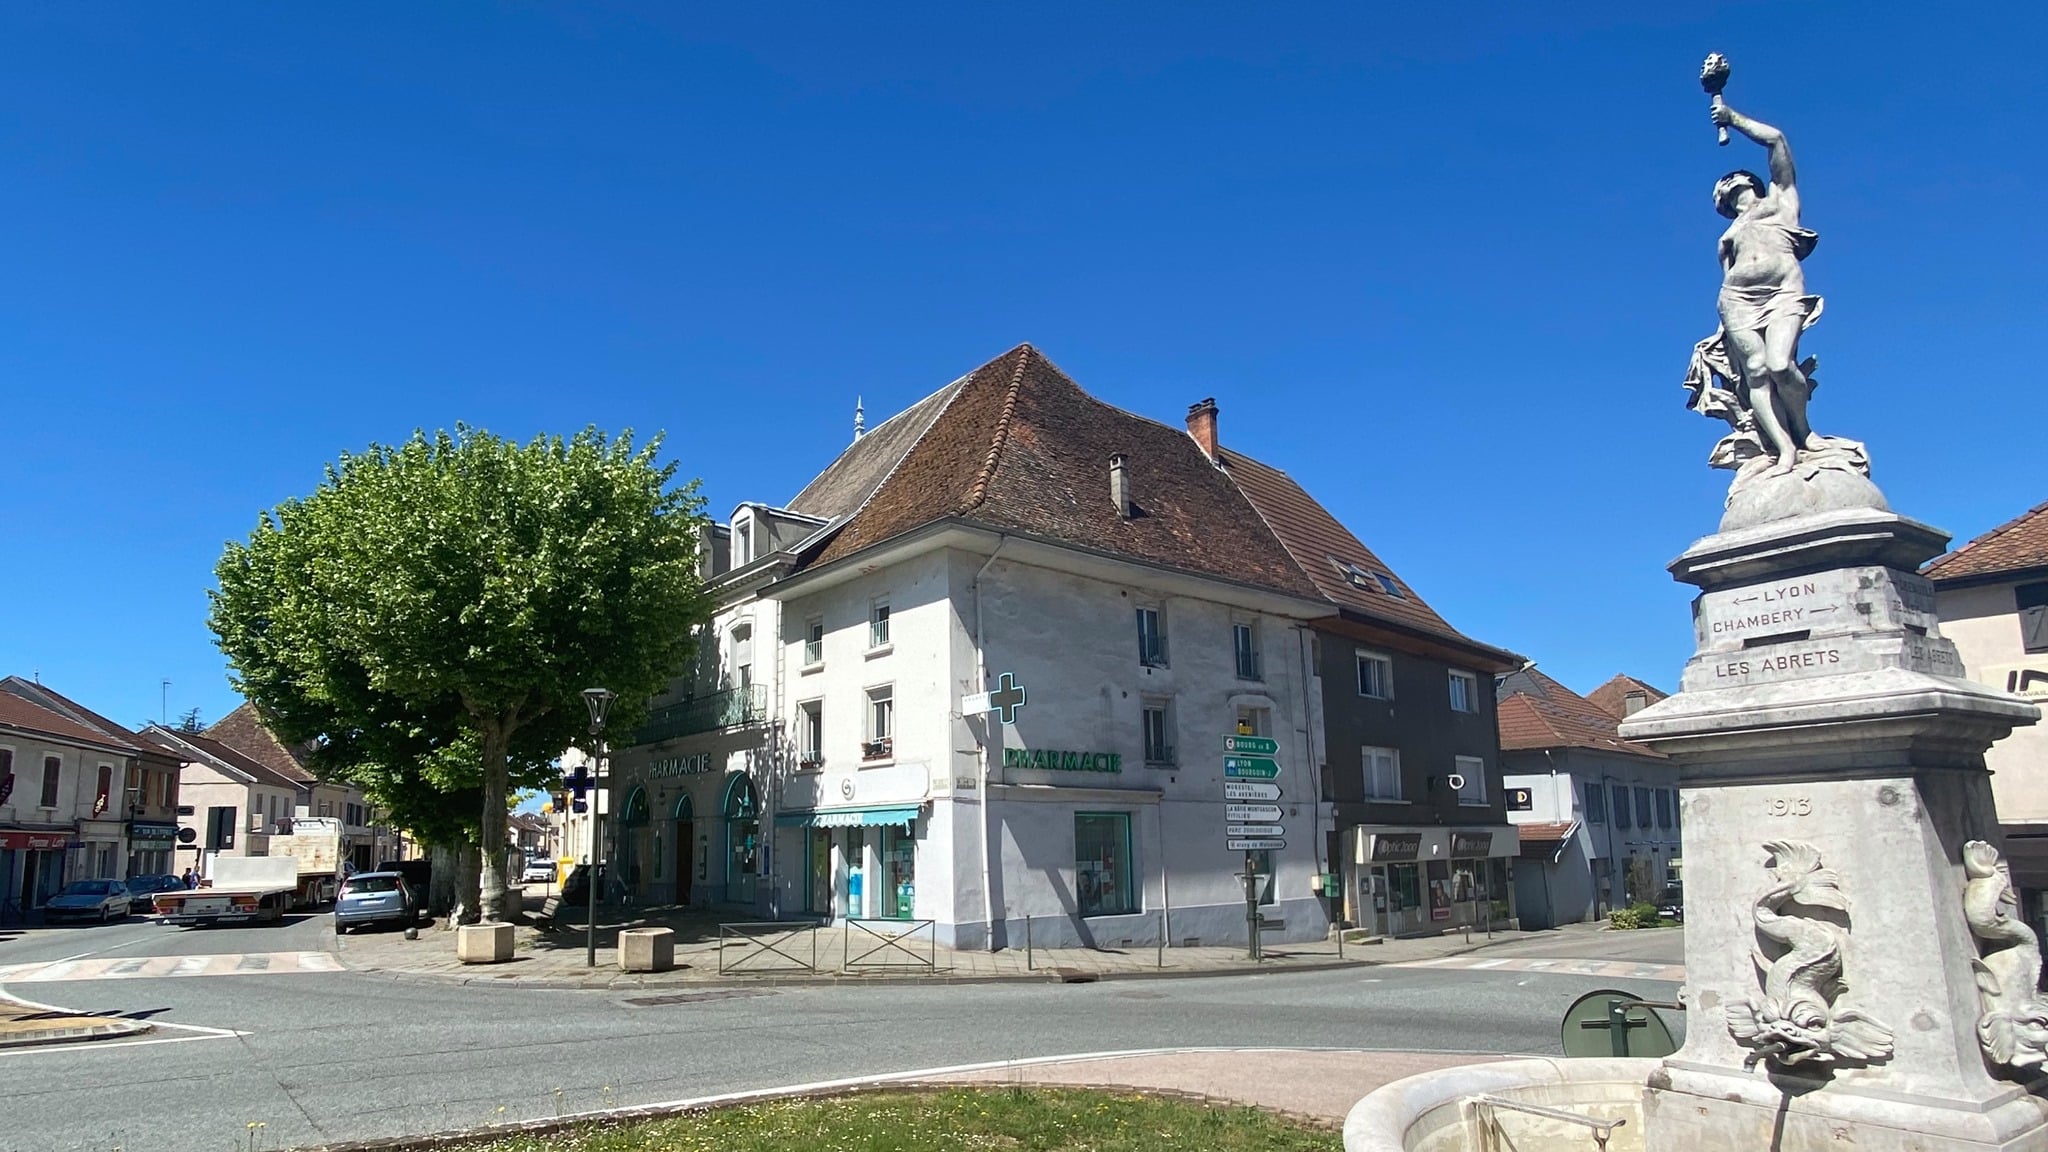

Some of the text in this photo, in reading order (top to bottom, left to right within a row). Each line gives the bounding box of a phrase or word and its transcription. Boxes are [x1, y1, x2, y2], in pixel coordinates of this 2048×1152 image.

[1764, 583, 1815, 602] LYON
[1713, 608, 1804, 633] CHAMBERY
[1716, 650, 1840, 678] LES ABRETS
[1236, 741, 1257, 749] BOURG
[648, 753, 710, 780] PHARMACIE
[1003, 747, 1122, 774] PHARMACIE
[1227, 790, 1237, 798] LES
